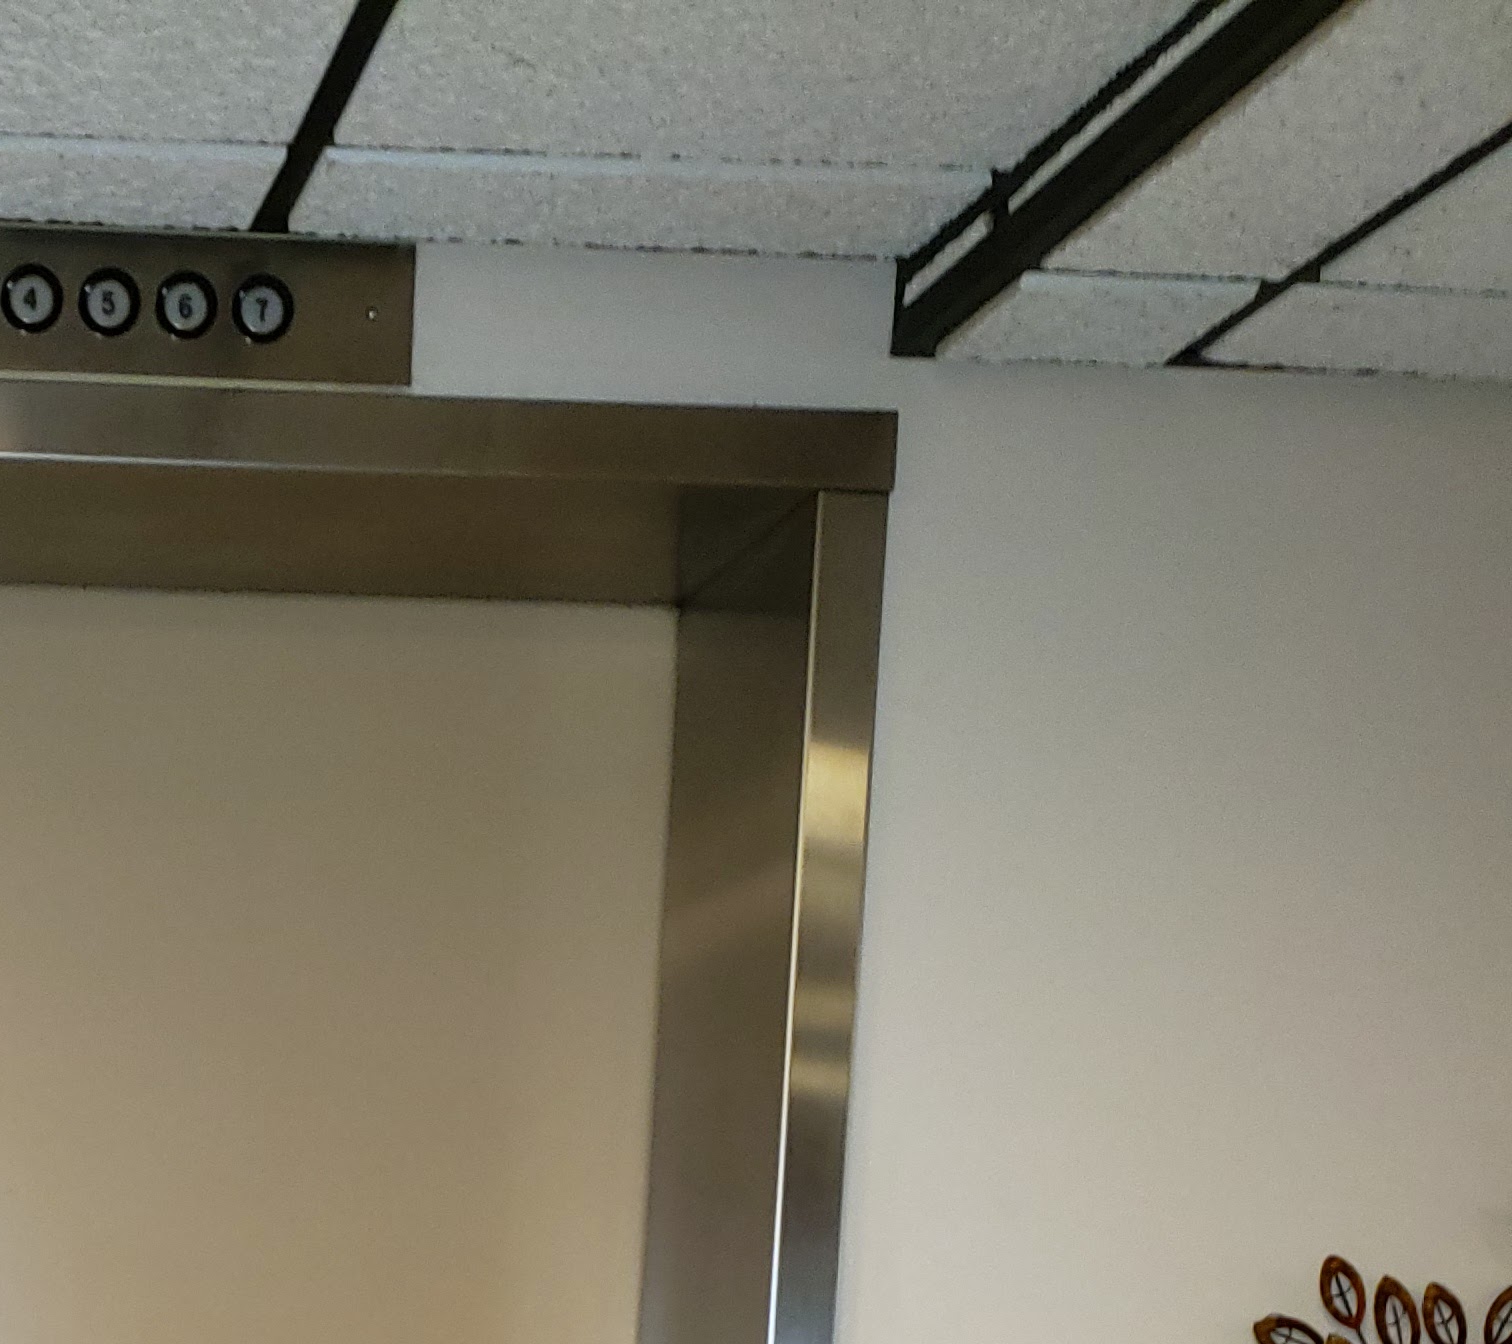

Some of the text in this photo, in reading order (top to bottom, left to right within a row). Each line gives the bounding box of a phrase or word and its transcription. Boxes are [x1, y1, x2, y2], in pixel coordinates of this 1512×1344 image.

[23, 286, 37, 310] 4
[102, 290, 115, 315] 5
[179, 293, 192, 318] 6
[256, 297, 267, 322] 7
